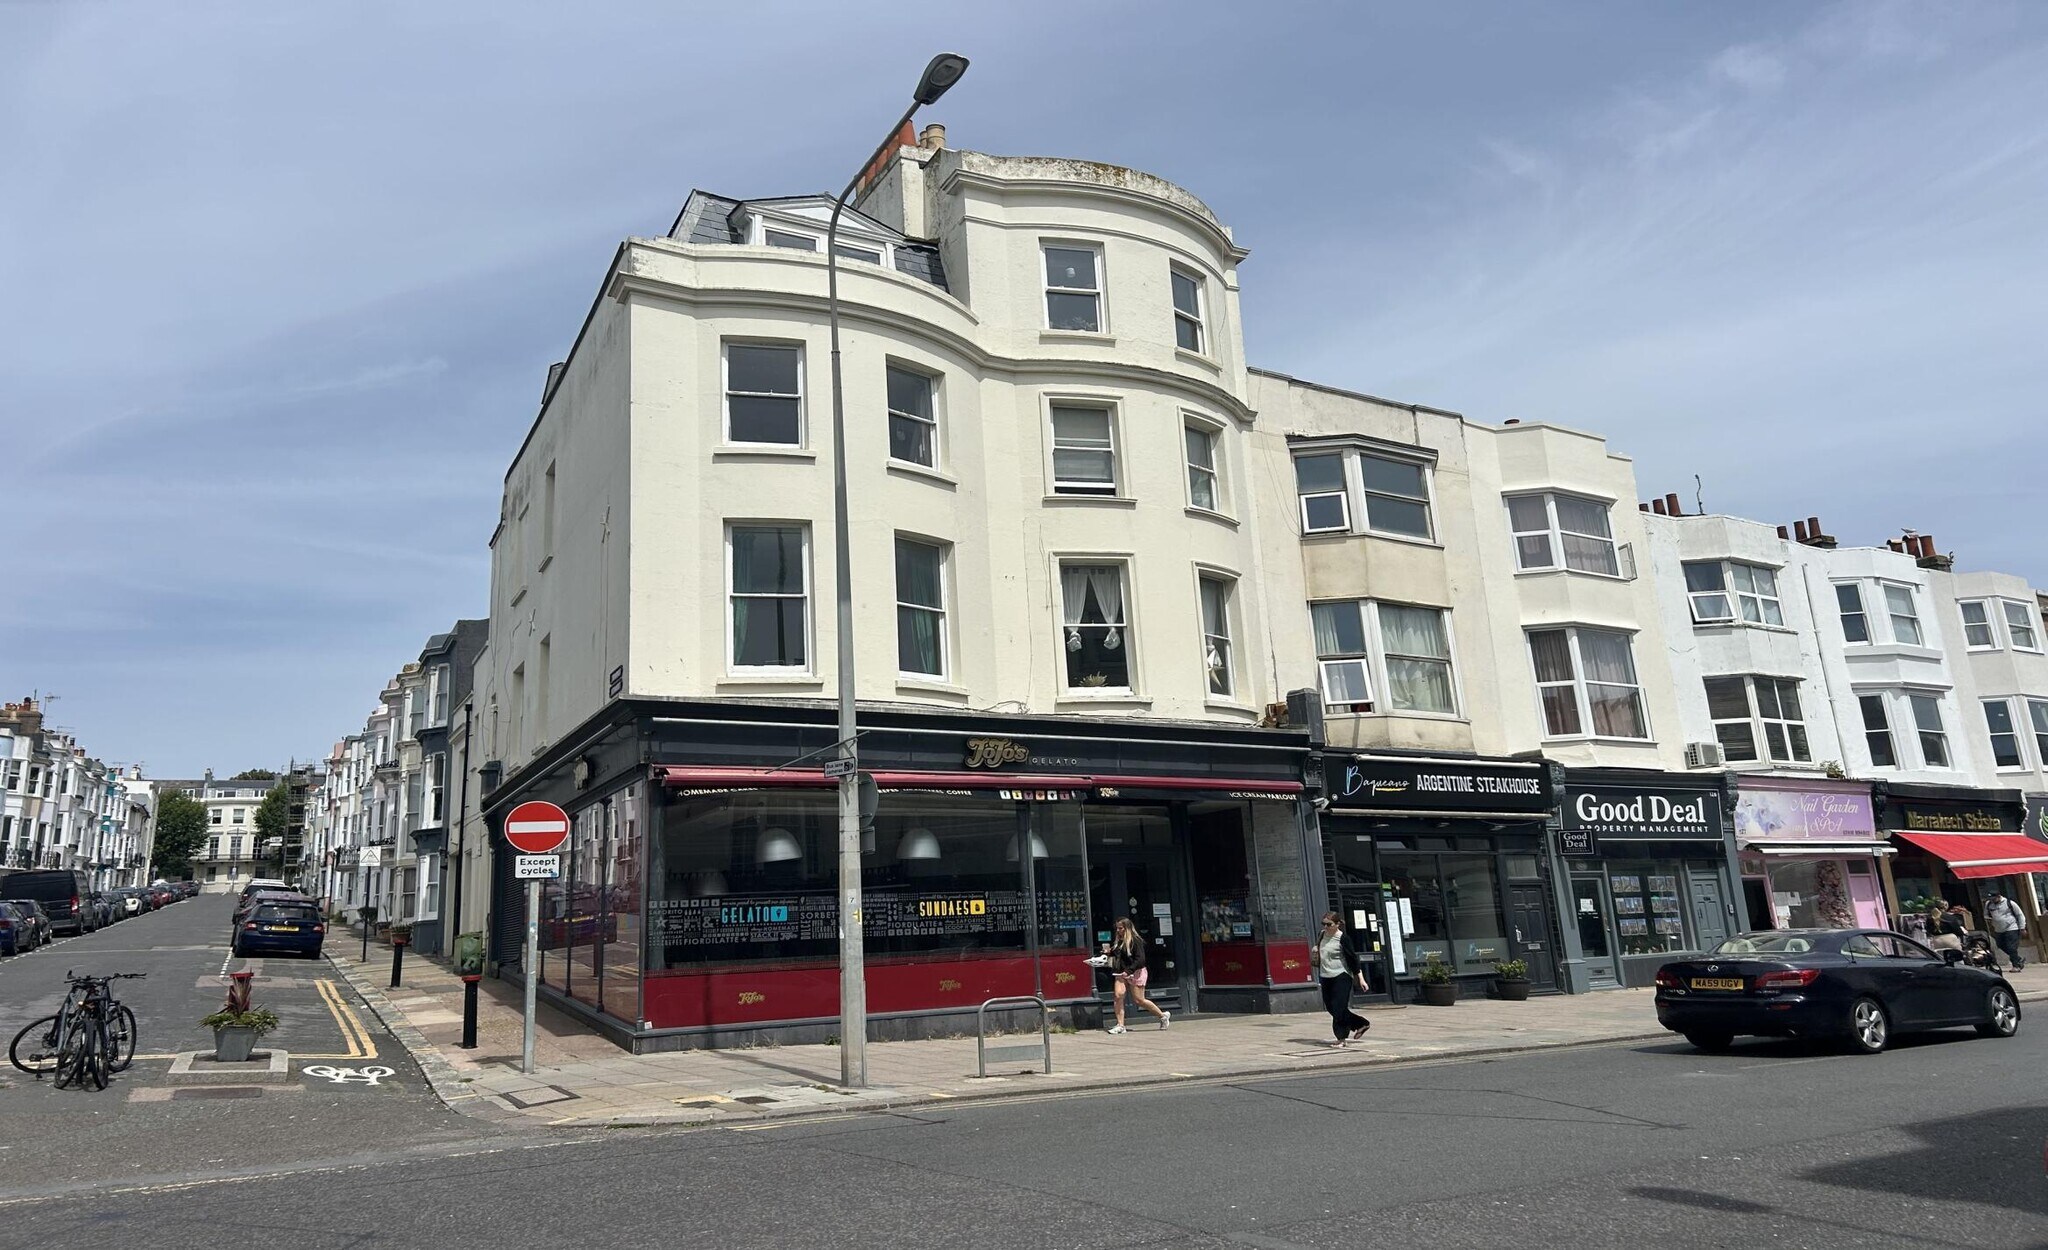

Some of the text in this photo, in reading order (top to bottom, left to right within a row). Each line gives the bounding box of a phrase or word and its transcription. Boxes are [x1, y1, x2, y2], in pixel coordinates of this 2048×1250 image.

[1032, 757, 1078, 765] GELATO
[1416, 774, 1475, 793] ARGENTINE
[1477, 776, 1541, 795] STEAKHOUSE
[676, 788, 729, 797] HOMEMADE
[1576, 793, 1706, 823] Good Deal
[1791, 794, 1859, 818] Nail Garden
[1906, 809, 2001, 830] Marrakech Shisha
[1640, 825, 1709, 833] MANAGEMENT
[1563, 832, 1588, 841] Good
[1565, 840, 1587, 848] Deal
[520, 858, 556, 866] Except
[521, 867, 554, 876] cycles
[919, 900, 969, 917] SUNDAES
[986, 905, 1017, 914] SORBET
[721, 906, 770, 923] GELATO
[800, 911, 836, 919] SORBET
[683, 936, 740, 946] FIORDILATTE
[1721, 979, 1739, 988] UGV
